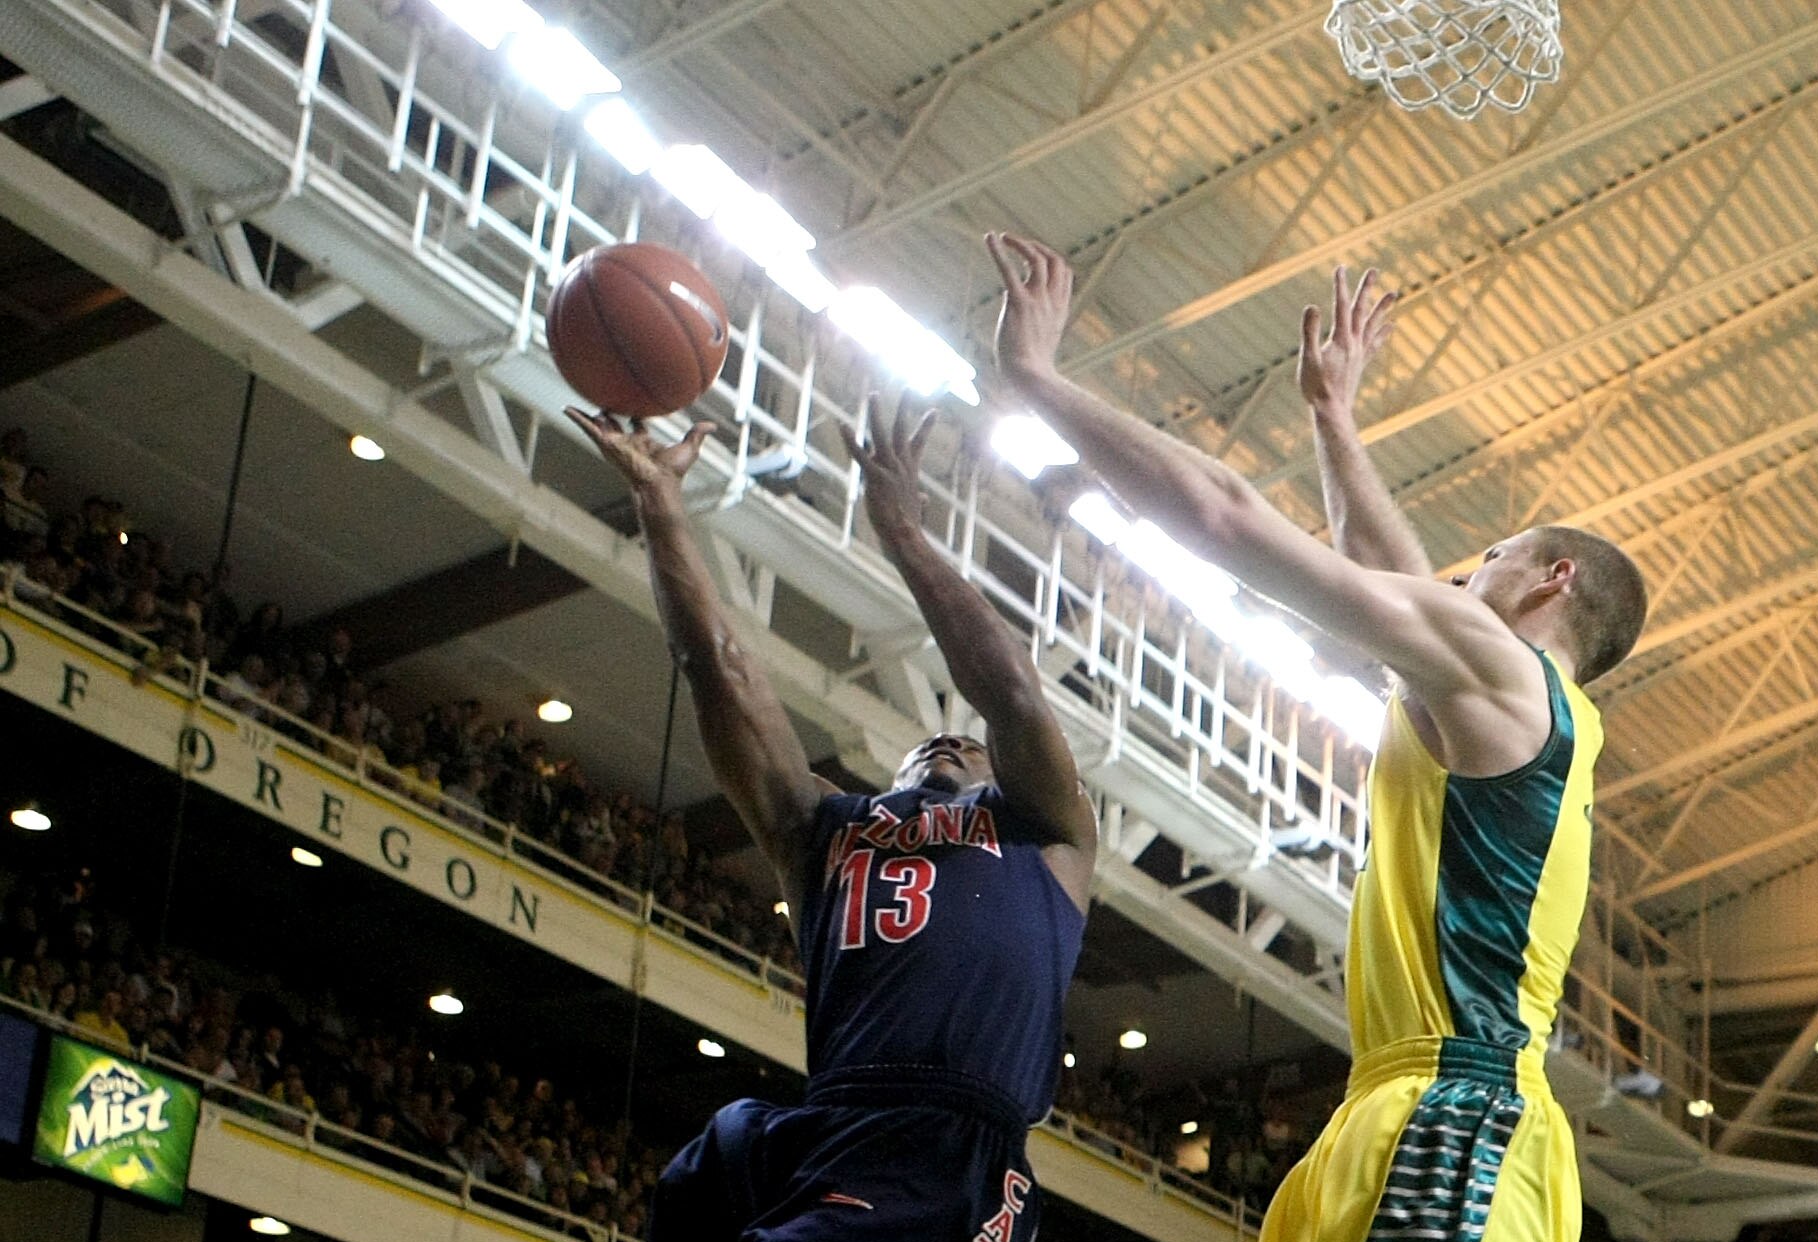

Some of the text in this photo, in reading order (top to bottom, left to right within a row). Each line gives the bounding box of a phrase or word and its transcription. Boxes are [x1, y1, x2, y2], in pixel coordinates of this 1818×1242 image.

[178, 724, 541, 933] OREGON
[838, 848, 937, 951] 13
[64, 1086, 171, 1158] Mist
